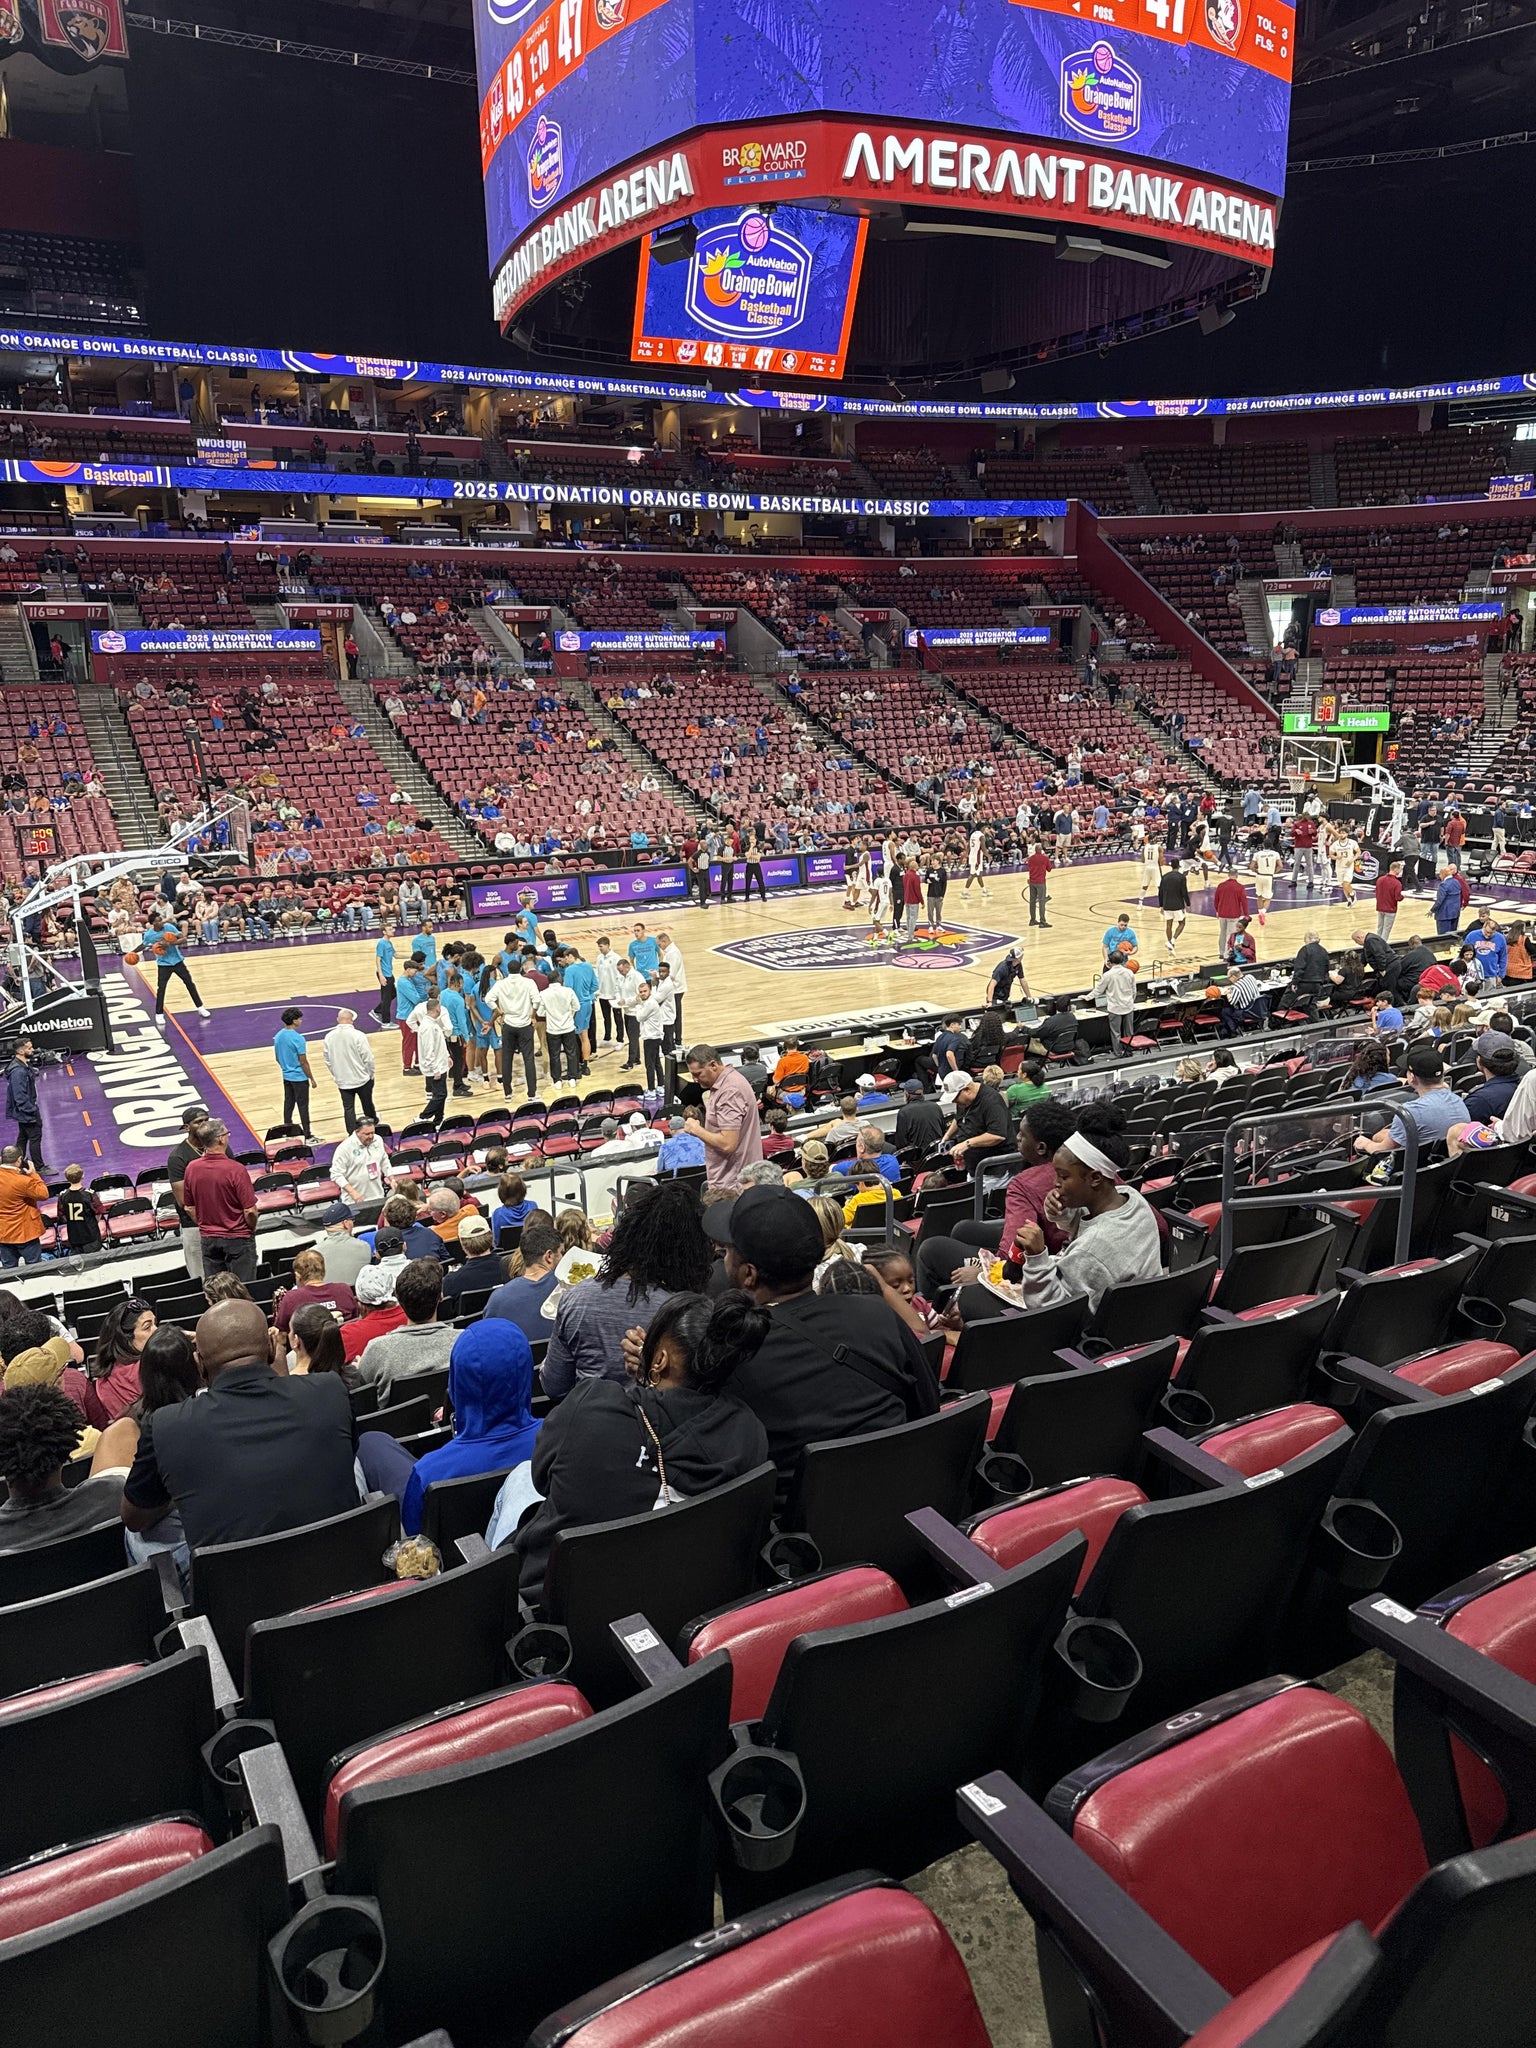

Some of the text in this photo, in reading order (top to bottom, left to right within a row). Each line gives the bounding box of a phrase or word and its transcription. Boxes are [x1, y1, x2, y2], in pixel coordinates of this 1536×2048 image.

[1093, 4, 1115, 22] POSS.
[1256, 14, 1288, 40] TOL: 3
[1255, 34, 1287, 59] FLS: 0
[529, 38, 549, 83] 1:10
[507, 51, 525, 121] 43
[1099, 75, 1133, 91] AutoNation
[1097, 109, 1132, 126] Basketball
[1103, 119, 1127, 133] Classic
[723, 141, 807, 167] BROWARD
[763, 158, 805, 172] COUNTY
[727, 170, 803, 185] FLORIDA
[842, 131, 1275, 249] AMERANT BANK ARENA
[541, 153, 694, 265] BANK ARENA
[746, 254, 798, 272] AutoNation
[740, 299, 792, 317] Basketball
[747, 311, 783, 326] Classic
[24, 336, 79, 350] ORANGE
[83, 340, 120, 353] BOWL
[124, 344, 203, 359] BASKETBALL
[207, 350, 258, 363] CLASSIC
[703, 343, 723, 366] 43
[731, 351, 746, 363] 1:10
[754, 348, 773, 369] 47
[356, 363, 397, 378] Classic
[440, 370, 707, 398] 2025 AUTONATION ORANGE BOWL BASKETBALL CLASSIC
[780, 397, 811, 409] Classic
[1226, 382, 1500, 411] 2025 AUTONATION ORANGE BOWL BASKETBALL CLASSIC
[843, 401, 1078, 416] 2025 AUTONATION ORANGE BOWL BASKETBALL CLASSIC
[1155, 405, 1188, 415] Classic
[83, 467, 153, 483] Basketball
[453, 482, 930, 515] 2025 AUTONATION ORANGE BOWL BASKETBALL CLASSIC
[1503, 574, 1518, 582] 124
[1265, 582, 1327, 591] 123 124
[30, 607, 102, 617] 116 117
[336, 609, 349, 618] 118
[535, 611, 548, 620] 119
[722, 612, 734, 620] 120
[878, 612, 887, 620] 121
[1062, 609, 1074, 617] 122
[1408, 607, 1460, 615] AUTONATION
[1408, 613, 1459, 622] BASKETBALL
[141, 640, 316, 650] ORANGEBOWL BASKETBALL CLASSIC
[186, 633, 272, 642] 2025 AUTONATION
[644, 634, 690, 642] AUTONATION
[645, 641, 691, 649] BASKETBALL
[1318, 706, 1333, 721] 30
[1347, 717, 1379, 727] Health
[32, 828, 54, 839] 1:09
[31, 841, 49, 854] 30
[150, 857, 181, 866] GEICO
[653, 881, 684, 889] LAUDERDALE
[19, 1015, 94, 1036] AutoNation
[68, 1202, 84, 1221] 12
[1495, 1207, 1507, 1220] 12
